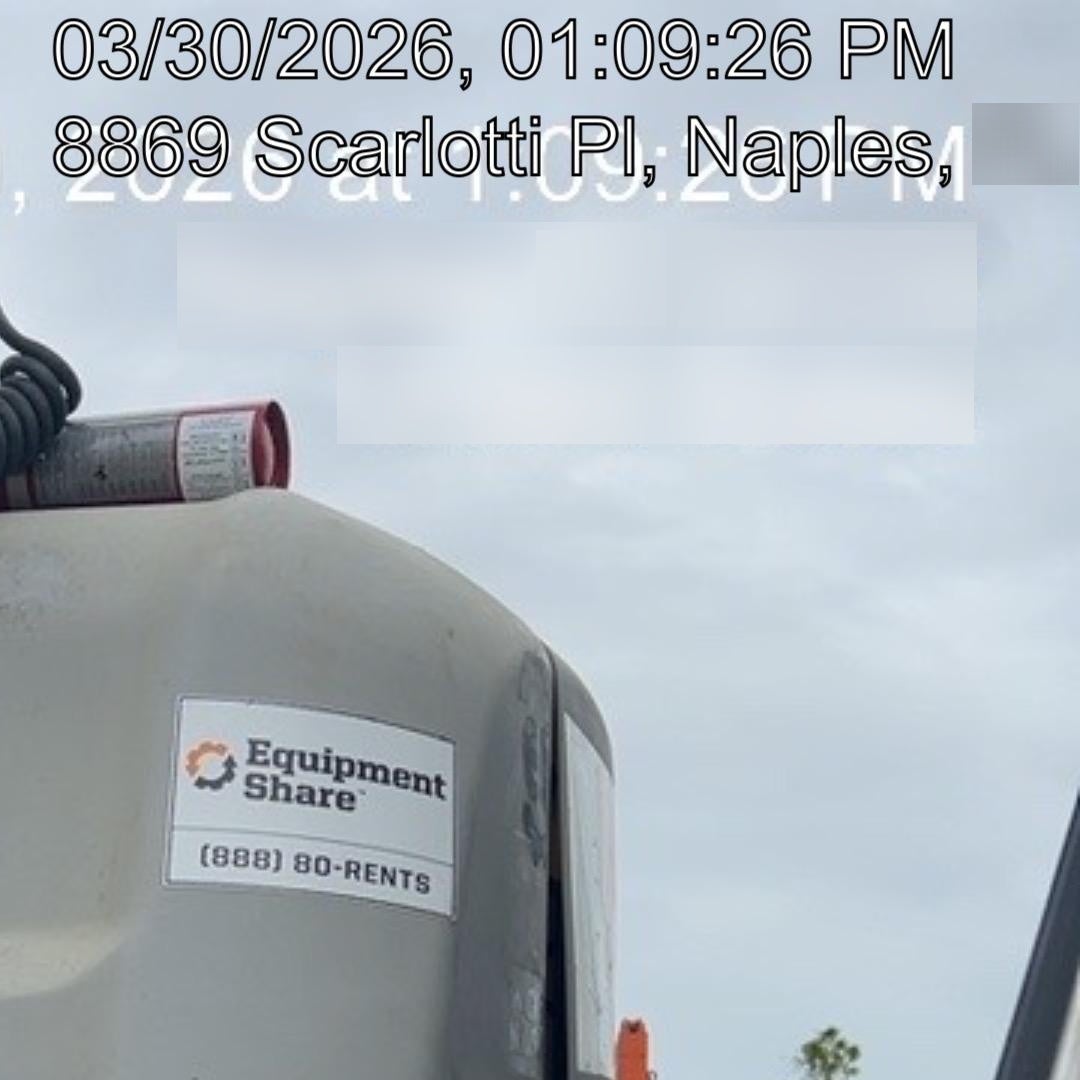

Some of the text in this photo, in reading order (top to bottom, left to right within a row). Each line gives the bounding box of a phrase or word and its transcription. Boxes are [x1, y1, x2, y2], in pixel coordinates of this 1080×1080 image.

[243, 773, 357, 812] Share
[246, 737, 447, 800] Equipment
[200, 843, 431, 895] (888) 80-RENTS
